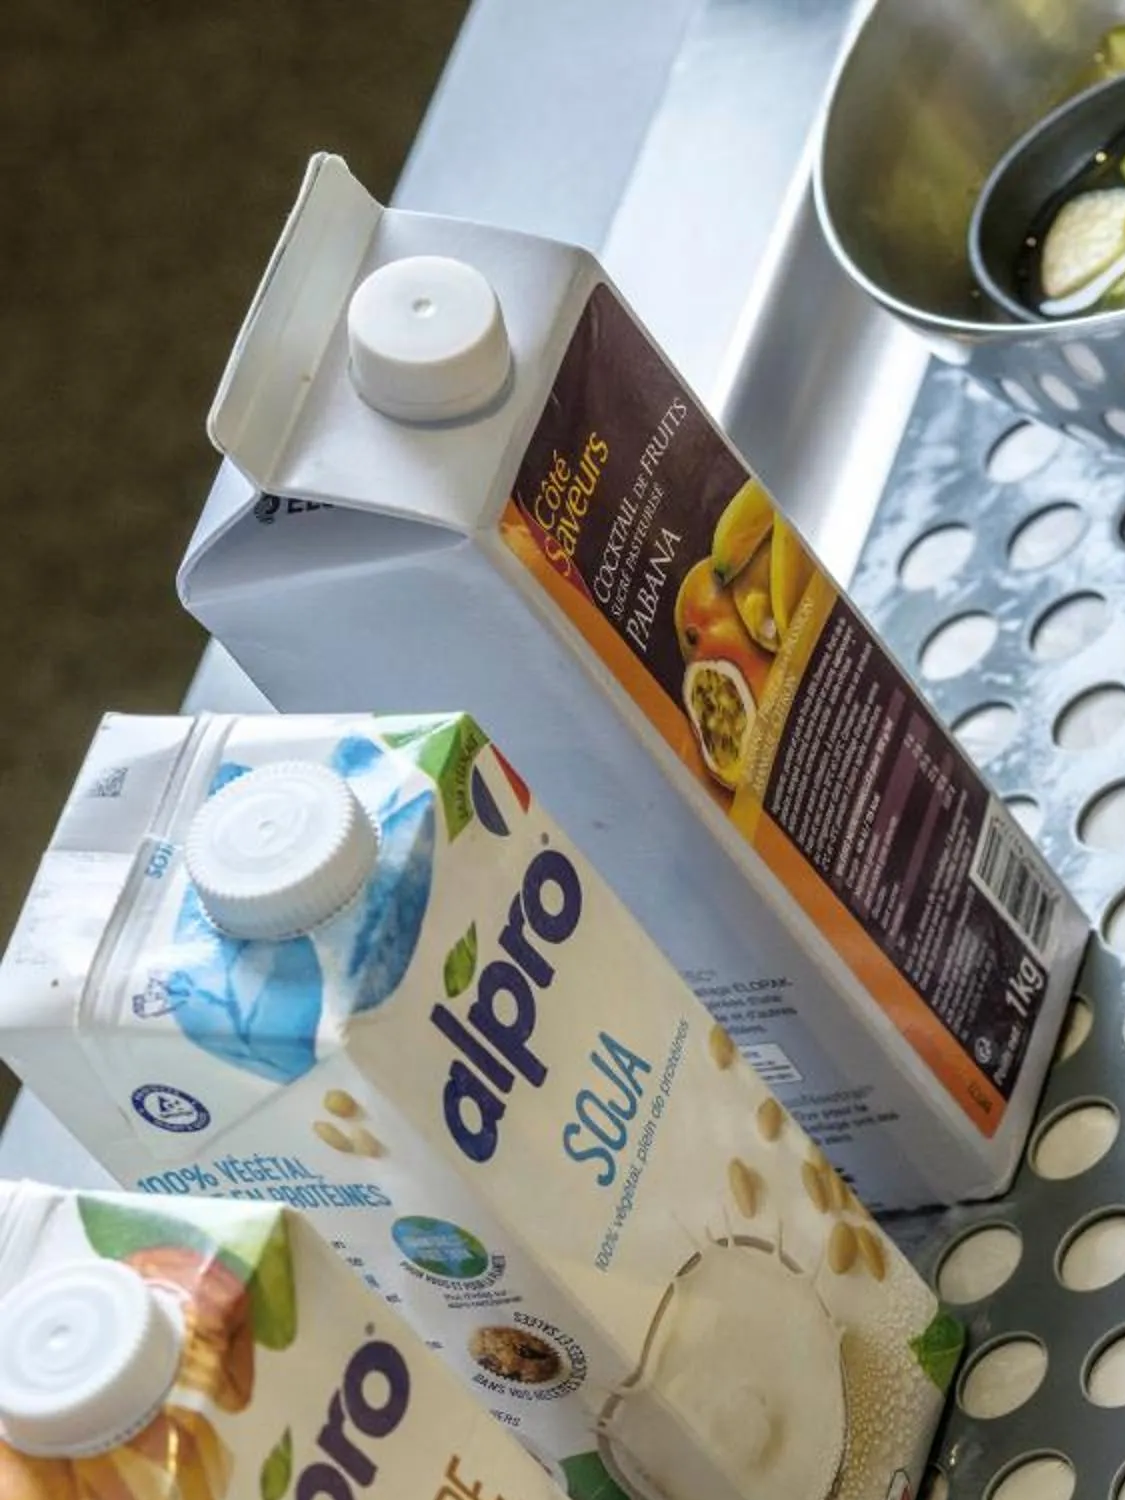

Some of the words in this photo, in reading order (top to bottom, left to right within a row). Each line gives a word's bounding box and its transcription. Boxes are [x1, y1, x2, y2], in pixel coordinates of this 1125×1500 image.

[534, 449, 572, 531] Côté
[632, 472, 650, 500] DE
[640, 396, 688, 477] FRUITS
[545, 431, 610, 577] Saveurs
[593, 497, 640, 604] COCKTAIL
[626, 527, 682, 652] PABANA
[429, 849, 584, 1164] alpro
[562, 1030, 653, 1187] SOJA
[267, 1179, 392, 1209] PROTÉINES
